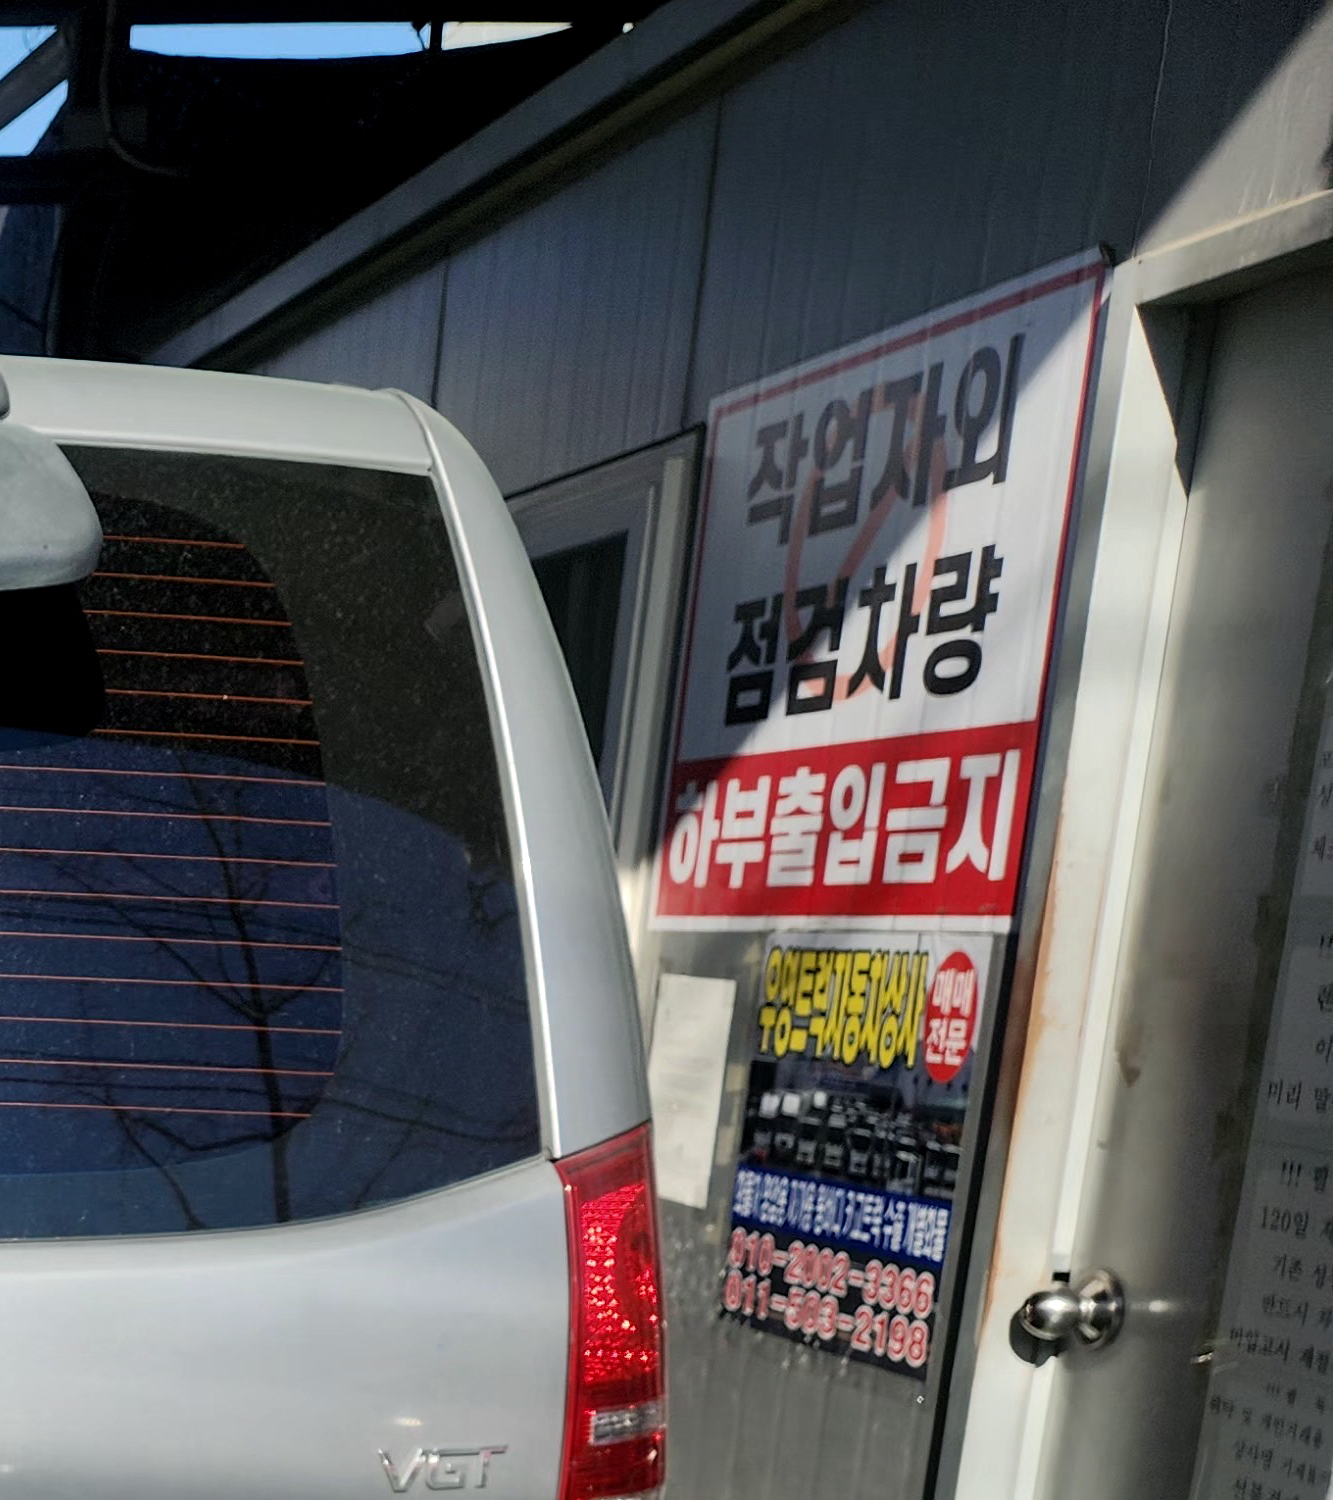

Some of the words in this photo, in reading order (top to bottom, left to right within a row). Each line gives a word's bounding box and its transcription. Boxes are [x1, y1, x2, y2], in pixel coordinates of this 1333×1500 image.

[746, 333, 1024, 546] 작업자외
[725, 544, 1004, 728] 점검차량
[668, 749, 1021, 890] 하부출입금지
[932, 968, 976, 1018] 매매
[925, 1017, 969, 1067] 전문
[377, 1444, 509, 1494] VGT
